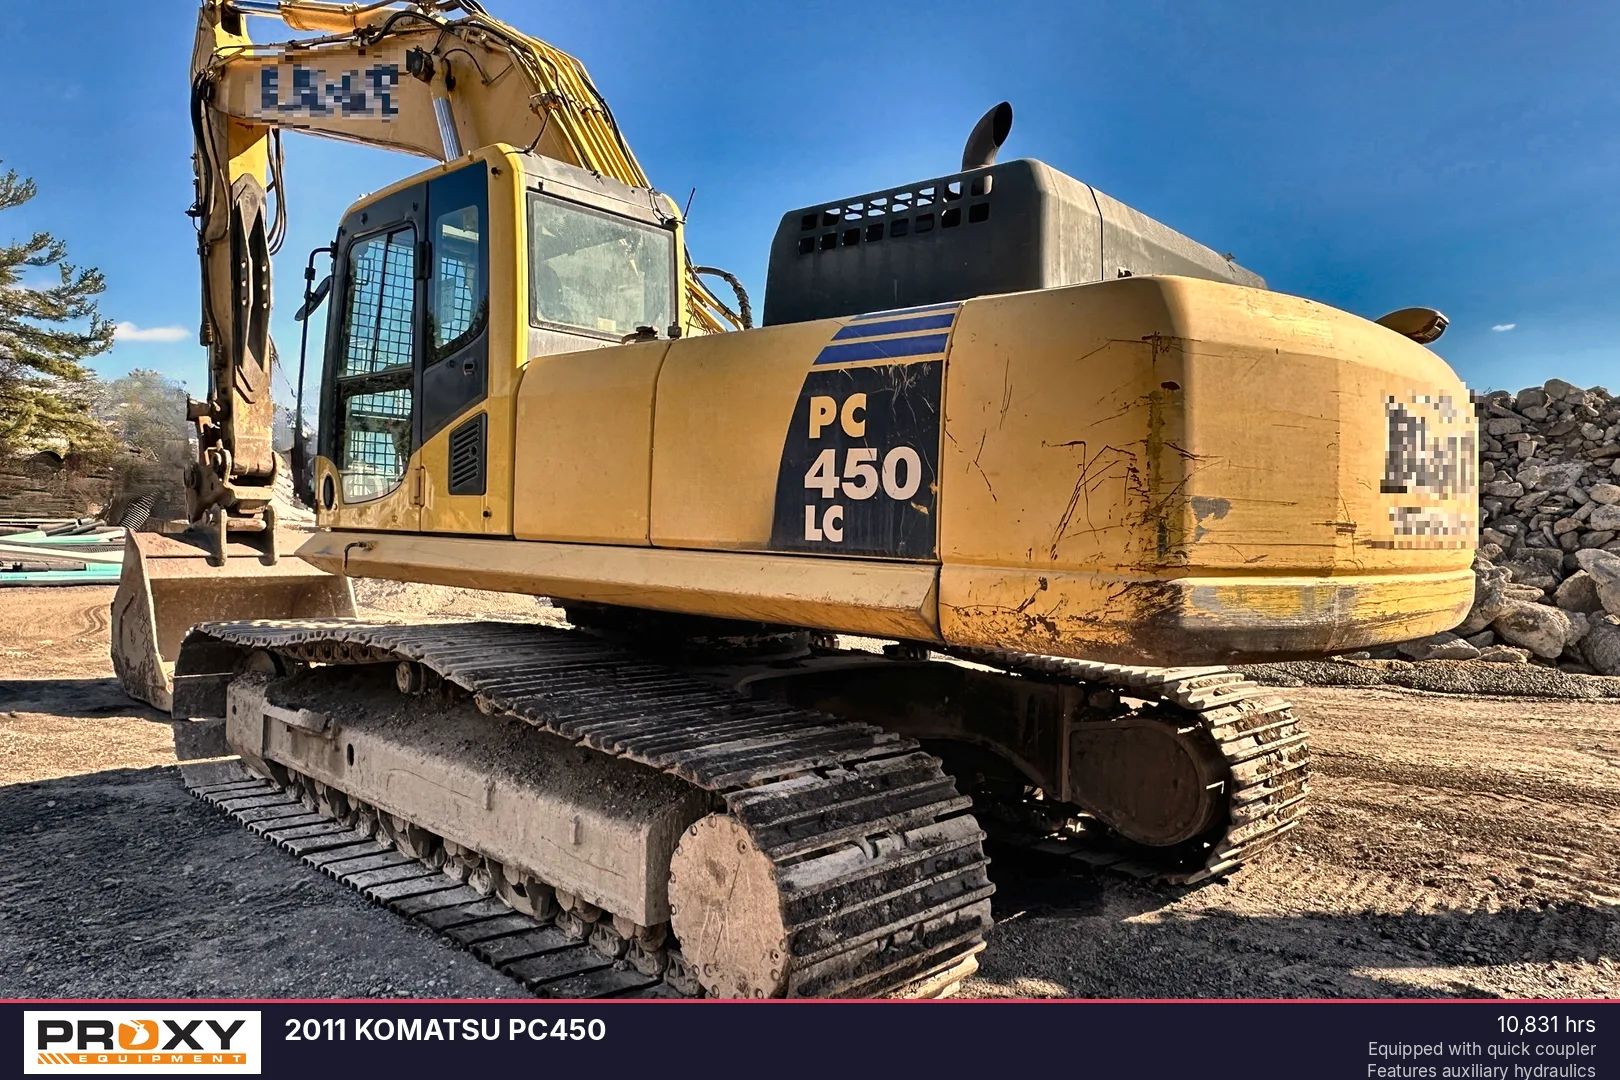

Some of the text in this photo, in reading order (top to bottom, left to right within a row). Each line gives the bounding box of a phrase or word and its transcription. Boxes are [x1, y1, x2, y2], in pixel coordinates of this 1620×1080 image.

[808, 392, 867, 439] PC
[804, 446, 922, 500] 450
[804, 504, 844, 542] LC
